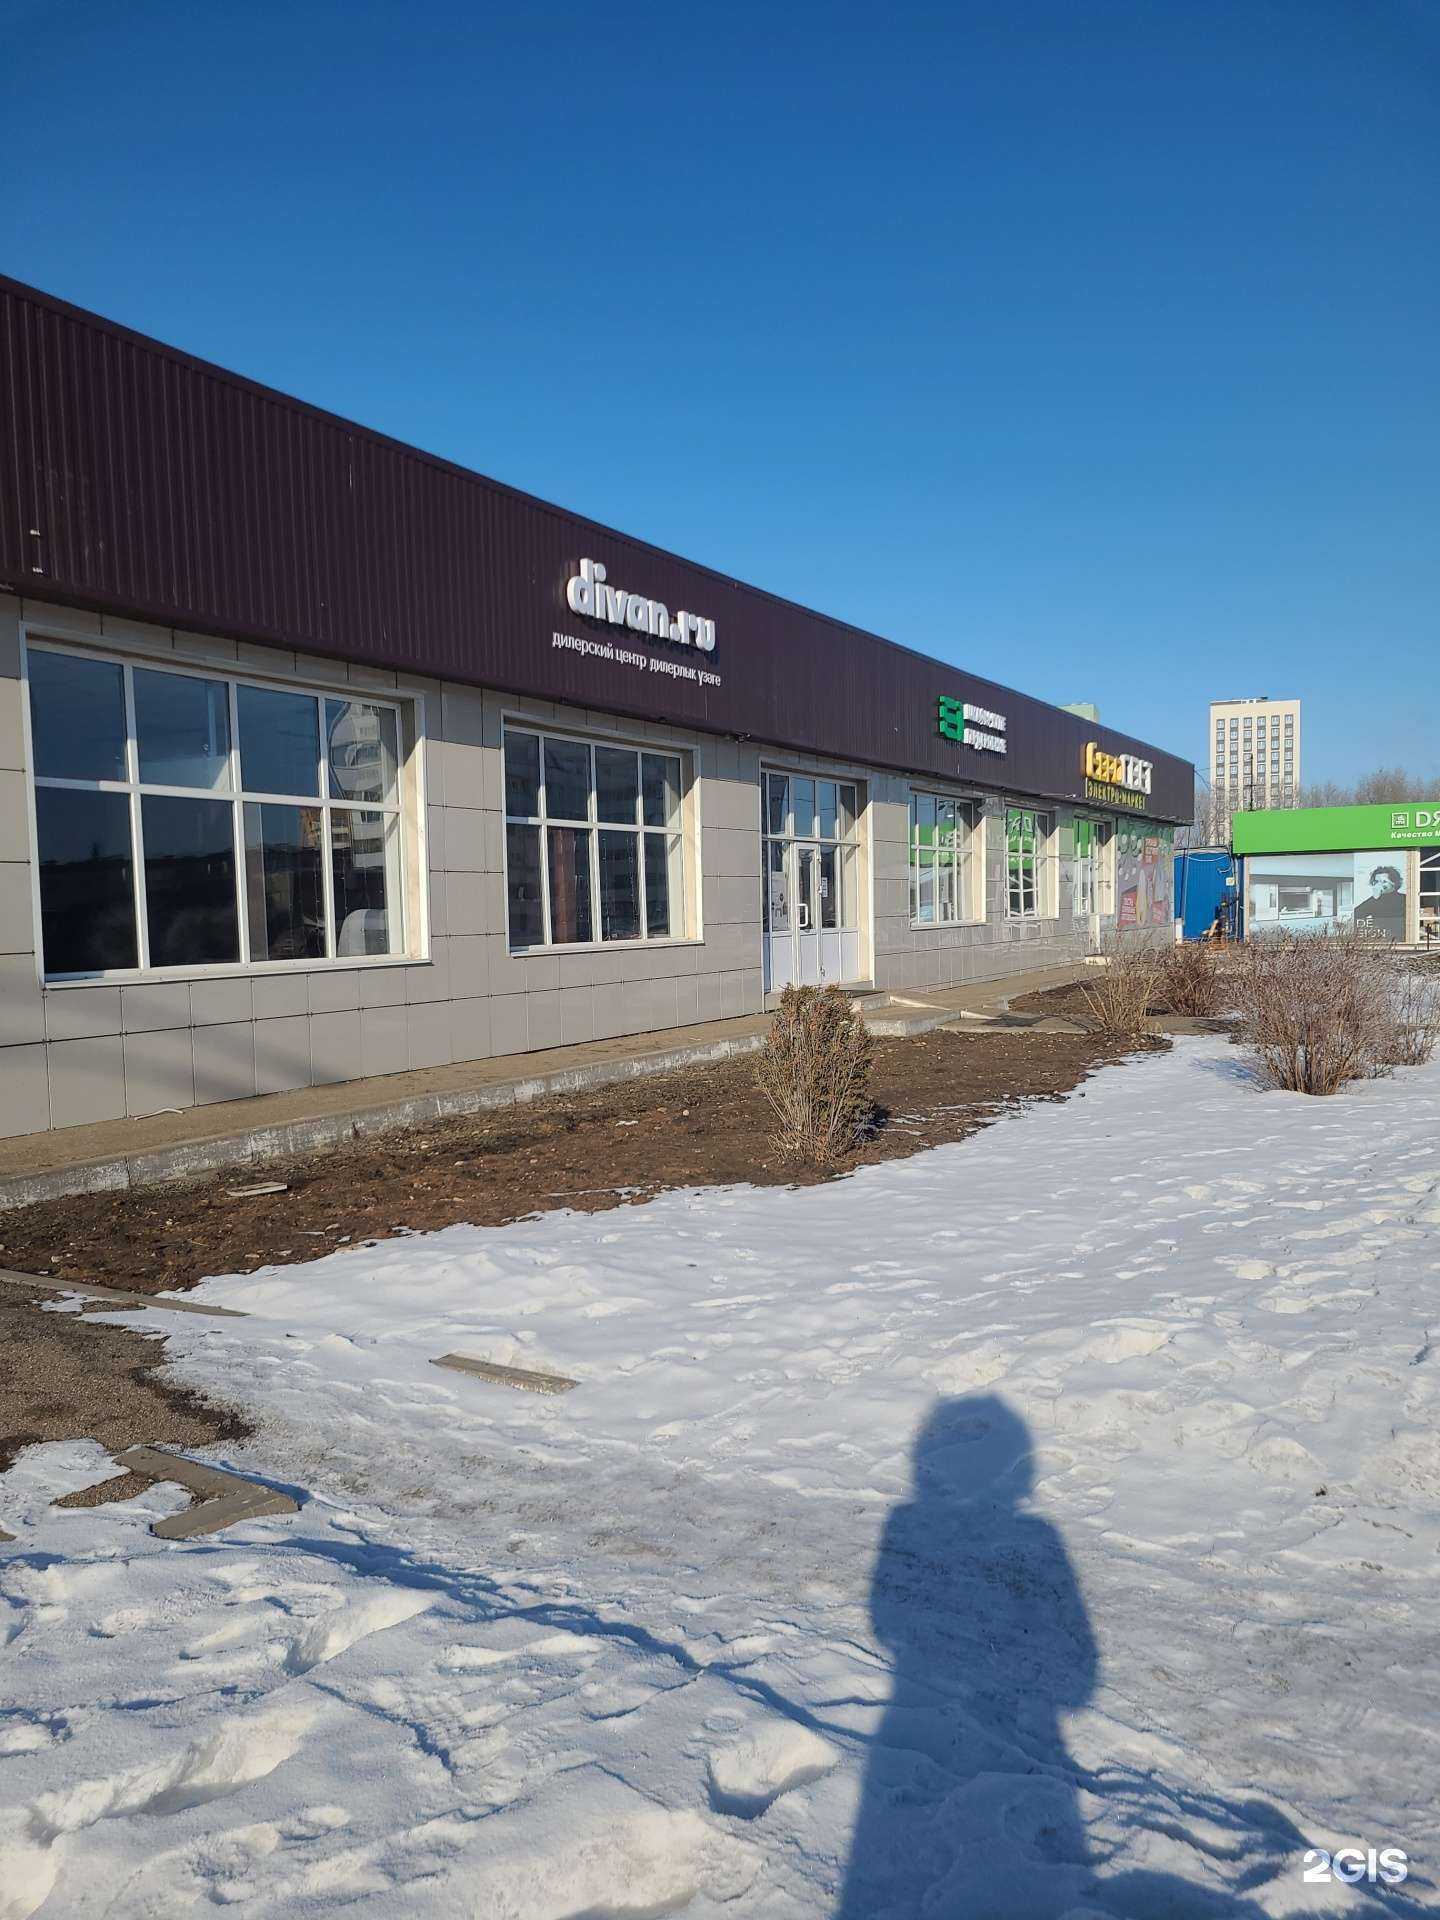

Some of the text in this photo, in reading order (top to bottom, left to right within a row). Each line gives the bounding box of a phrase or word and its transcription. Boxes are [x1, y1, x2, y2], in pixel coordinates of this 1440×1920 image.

[567, 558, 716, 651] divan.ru
[552, 631, 614, 660] дилерский
[616, 649, 647, 670] центр
[649, 657, 697, 681] дилерлык
